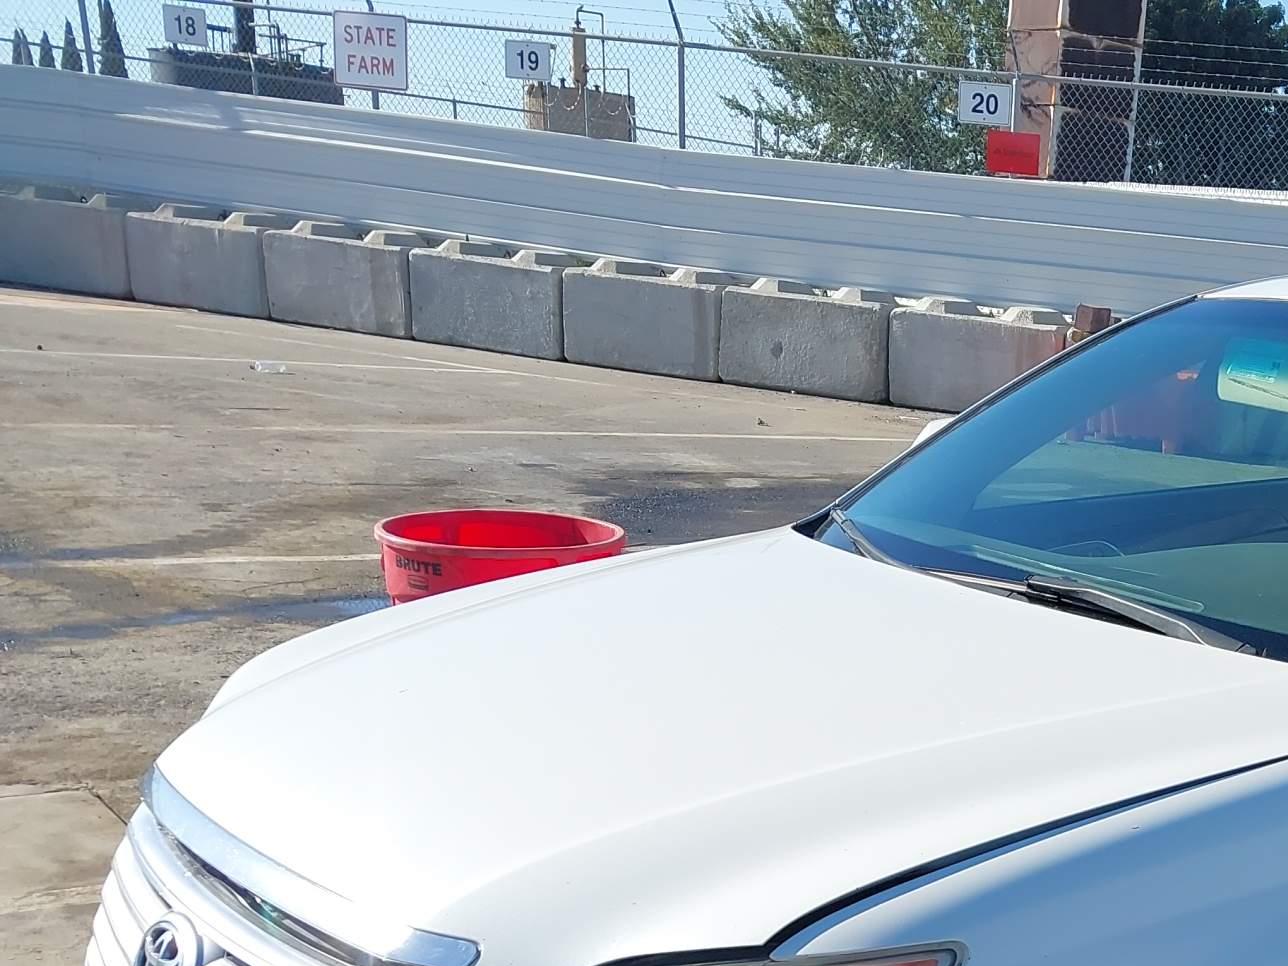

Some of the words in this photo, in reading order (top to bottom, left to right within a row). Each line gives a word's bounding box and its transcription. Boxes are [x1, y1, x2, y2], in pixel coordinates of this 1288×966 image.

[174, 15, 197, 36] 18
[343, 24, 397, 48] STATE
[346, 54, 395, 77] FARM
[516, 49, 539, 71] 19
[971, 92, 999, 115] 20
[395, 554, 443, 577] BRUTE
